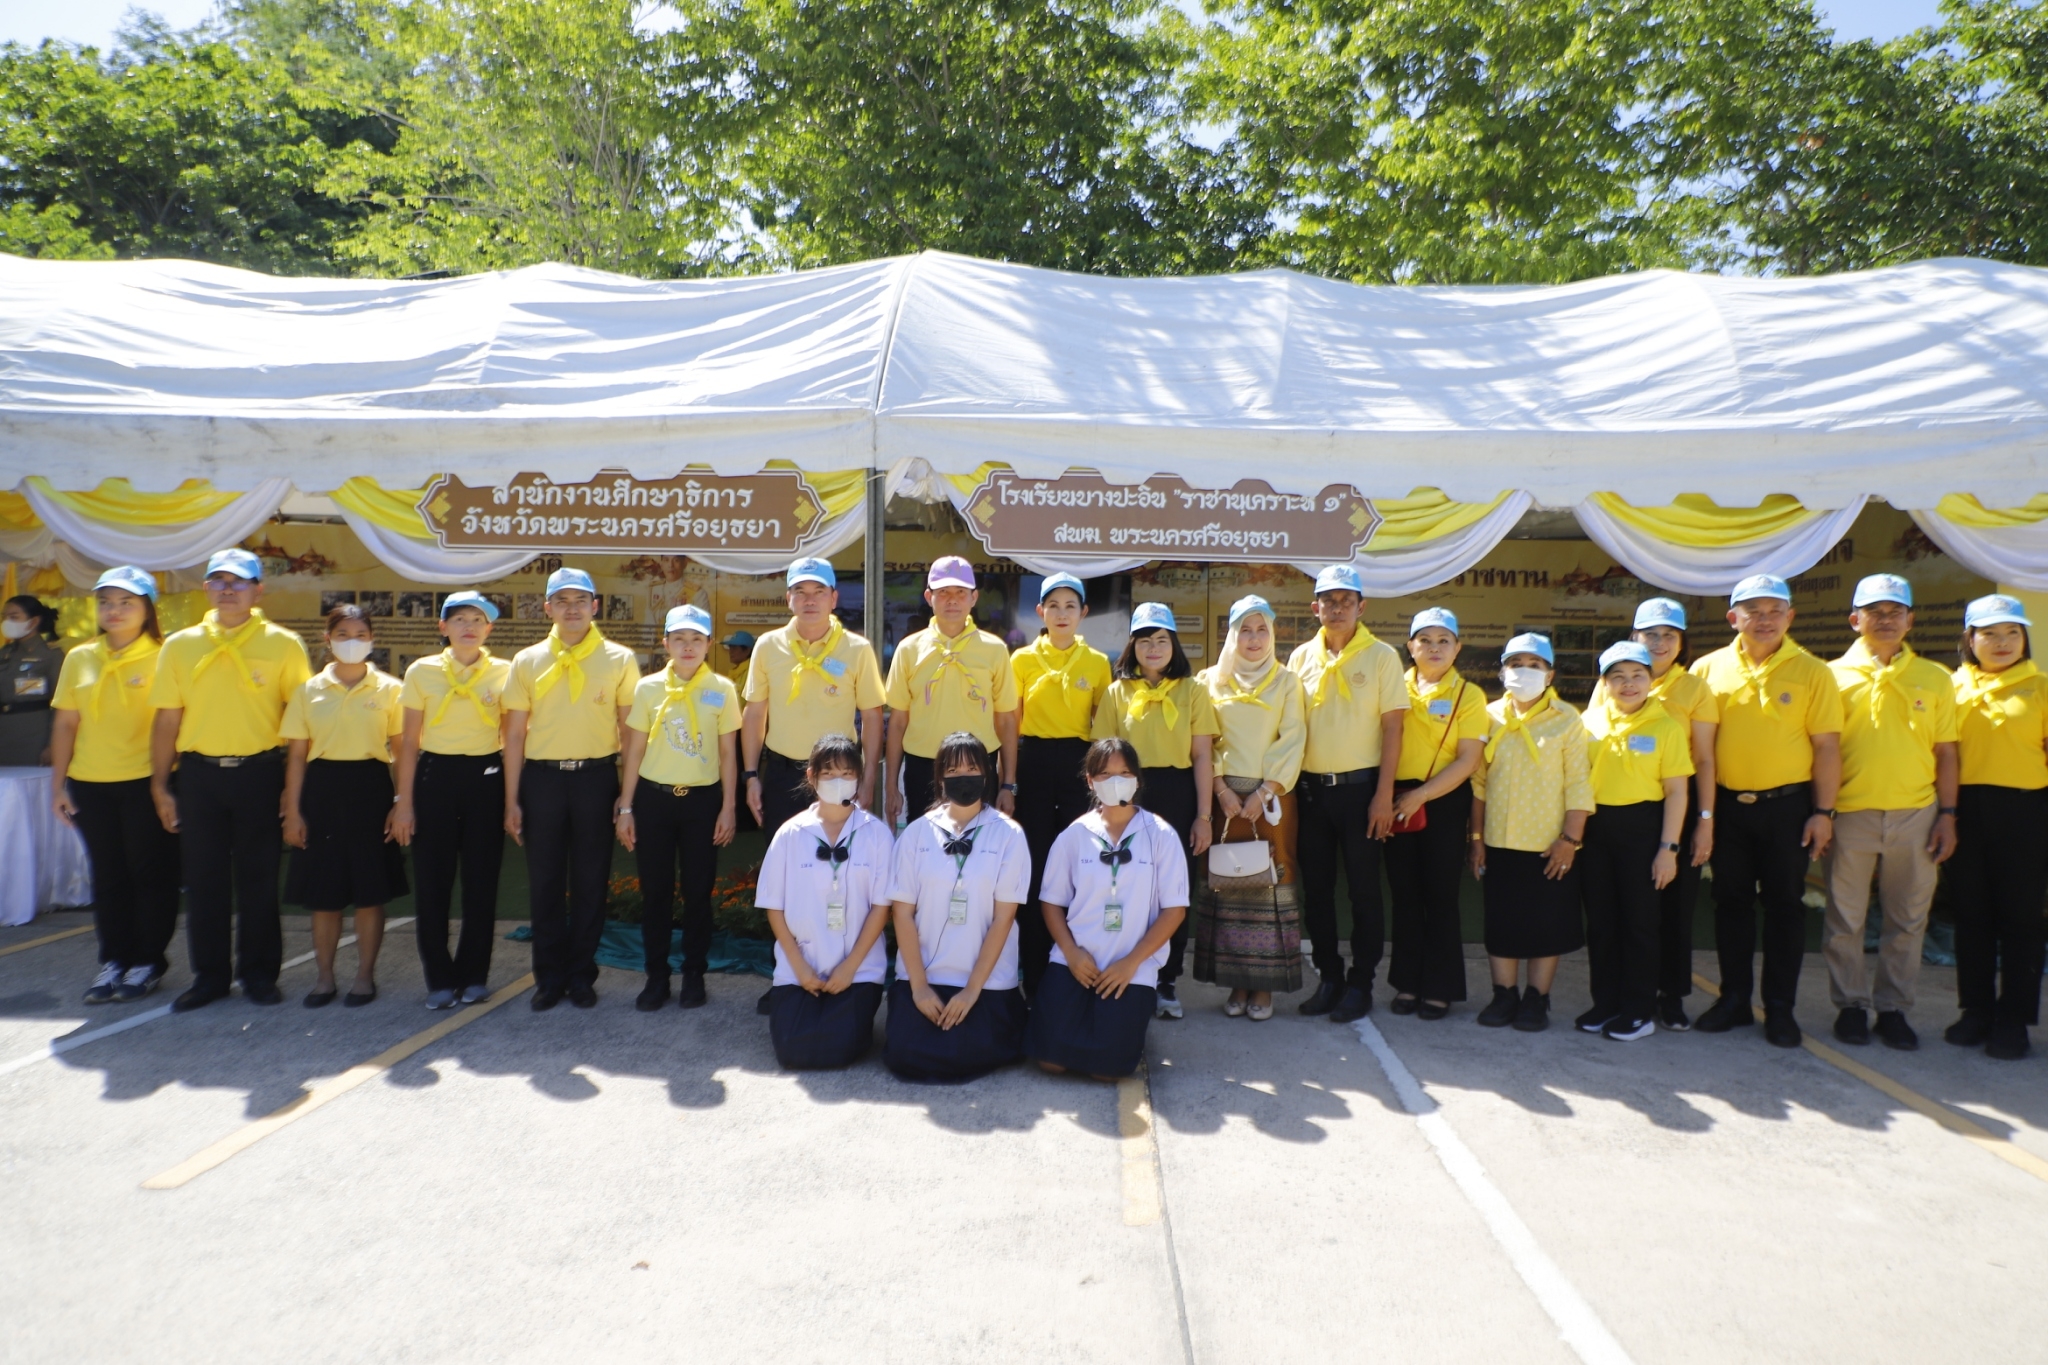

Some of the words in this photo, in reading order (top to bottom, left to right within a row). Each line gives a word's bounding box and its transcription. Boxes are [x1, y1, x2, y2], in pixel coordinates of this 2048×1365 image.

[997, 479, 1167, 508] โรงเรียนบางปะอิน
[460, 506, 781, 545] จังหวัดพระนครศรีอยุธยา
[1109, 522, 1290, 553] พระนครศรีอยุธยา
